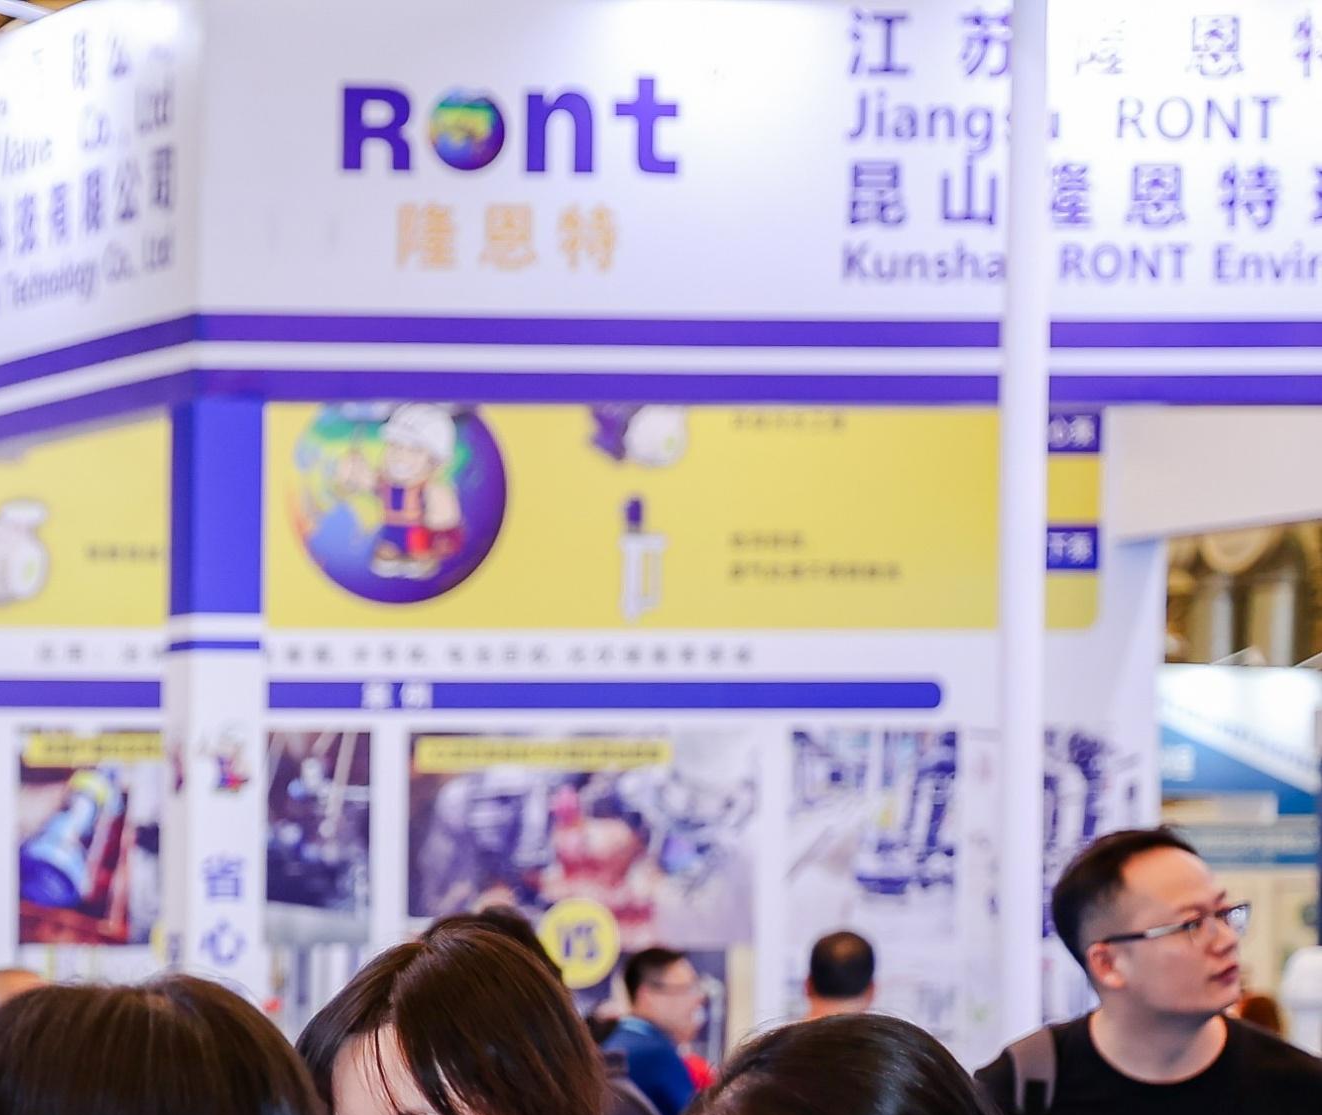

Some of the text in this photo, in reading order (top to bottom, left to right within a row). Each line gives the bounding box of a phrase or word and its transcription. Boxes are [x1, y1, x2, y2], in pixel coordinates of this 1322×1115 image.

[341, 77, 679, 175] Ront
[849, 89, 1282, 156] Jiang RONT
[850, 159, 1322, 227] 昆山隆恩特
[394, 202, 618, 272] 隆恩特
[843, 241, 1007, 280] Kunsha
[1058, 243, 1192, 281] RONT
